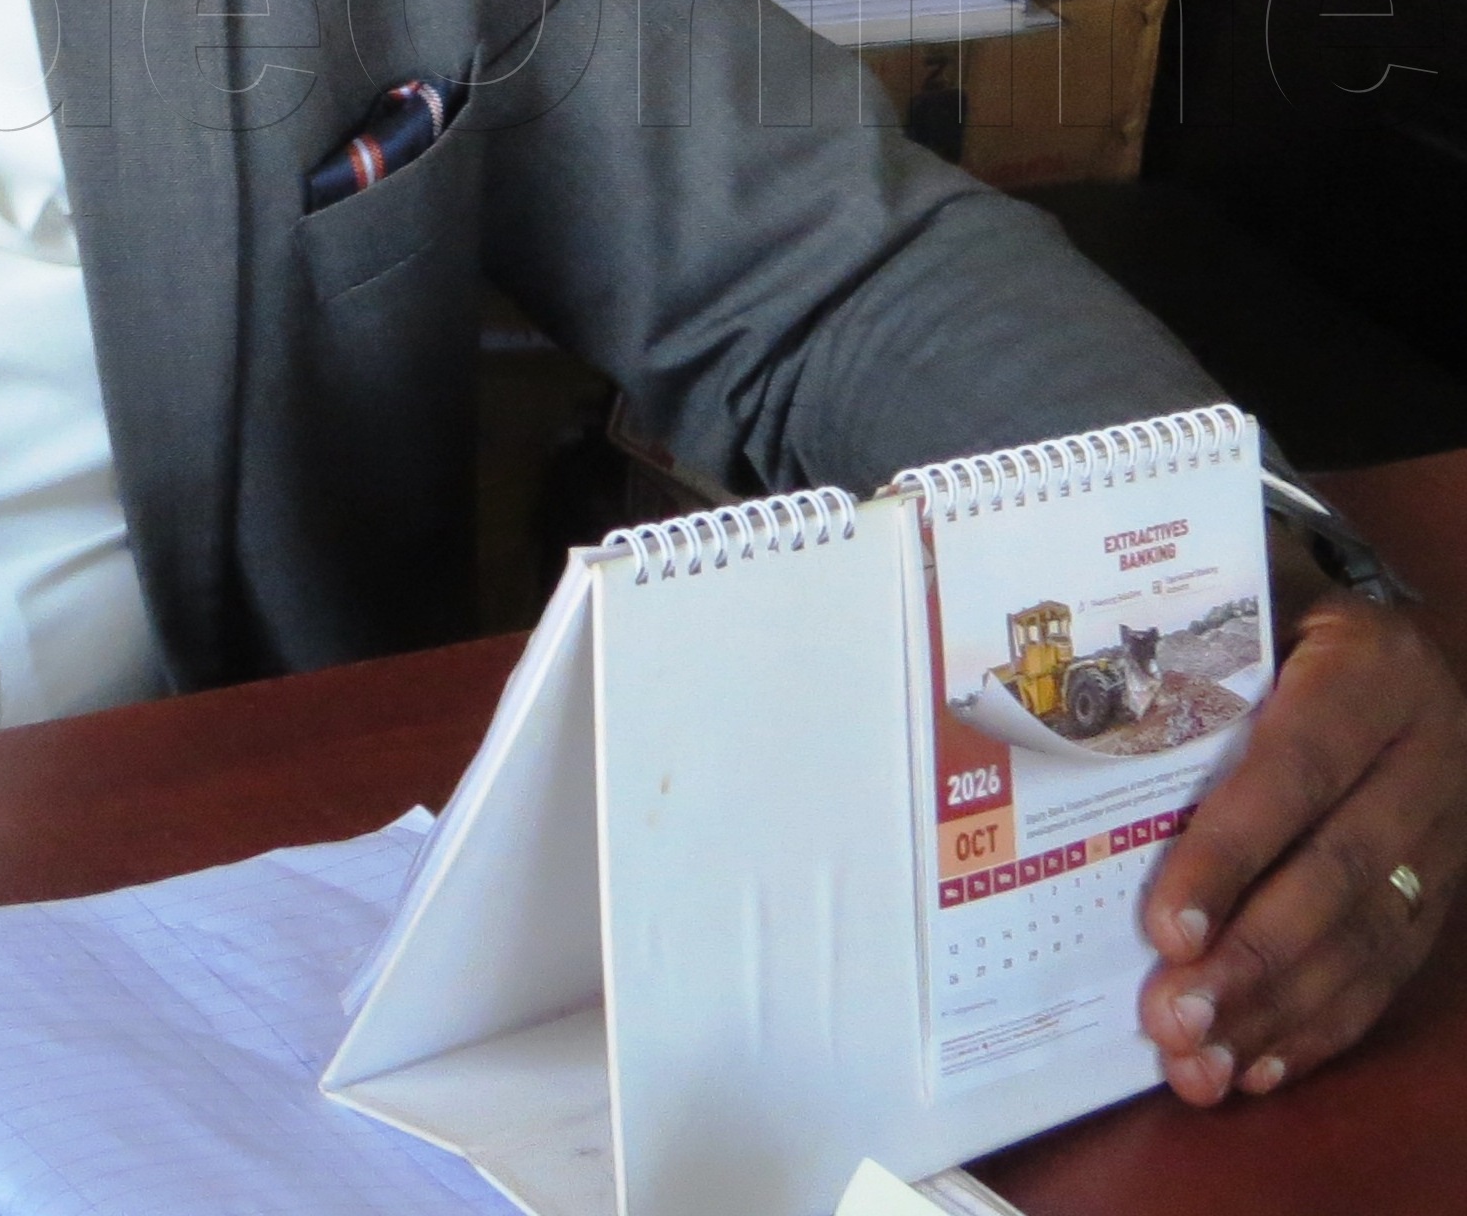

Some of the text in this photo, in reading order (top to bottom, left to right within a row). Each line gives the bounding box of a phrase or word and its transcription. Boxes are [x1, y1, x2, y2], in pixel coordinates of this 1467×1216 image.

[1104, 519, 1189, 554] EXTRACTIVES
[1119, 542, 1176, 572] BANKING
[947, 764, 1001, 806] 2026
[956, 824, 999, 861] OCT
